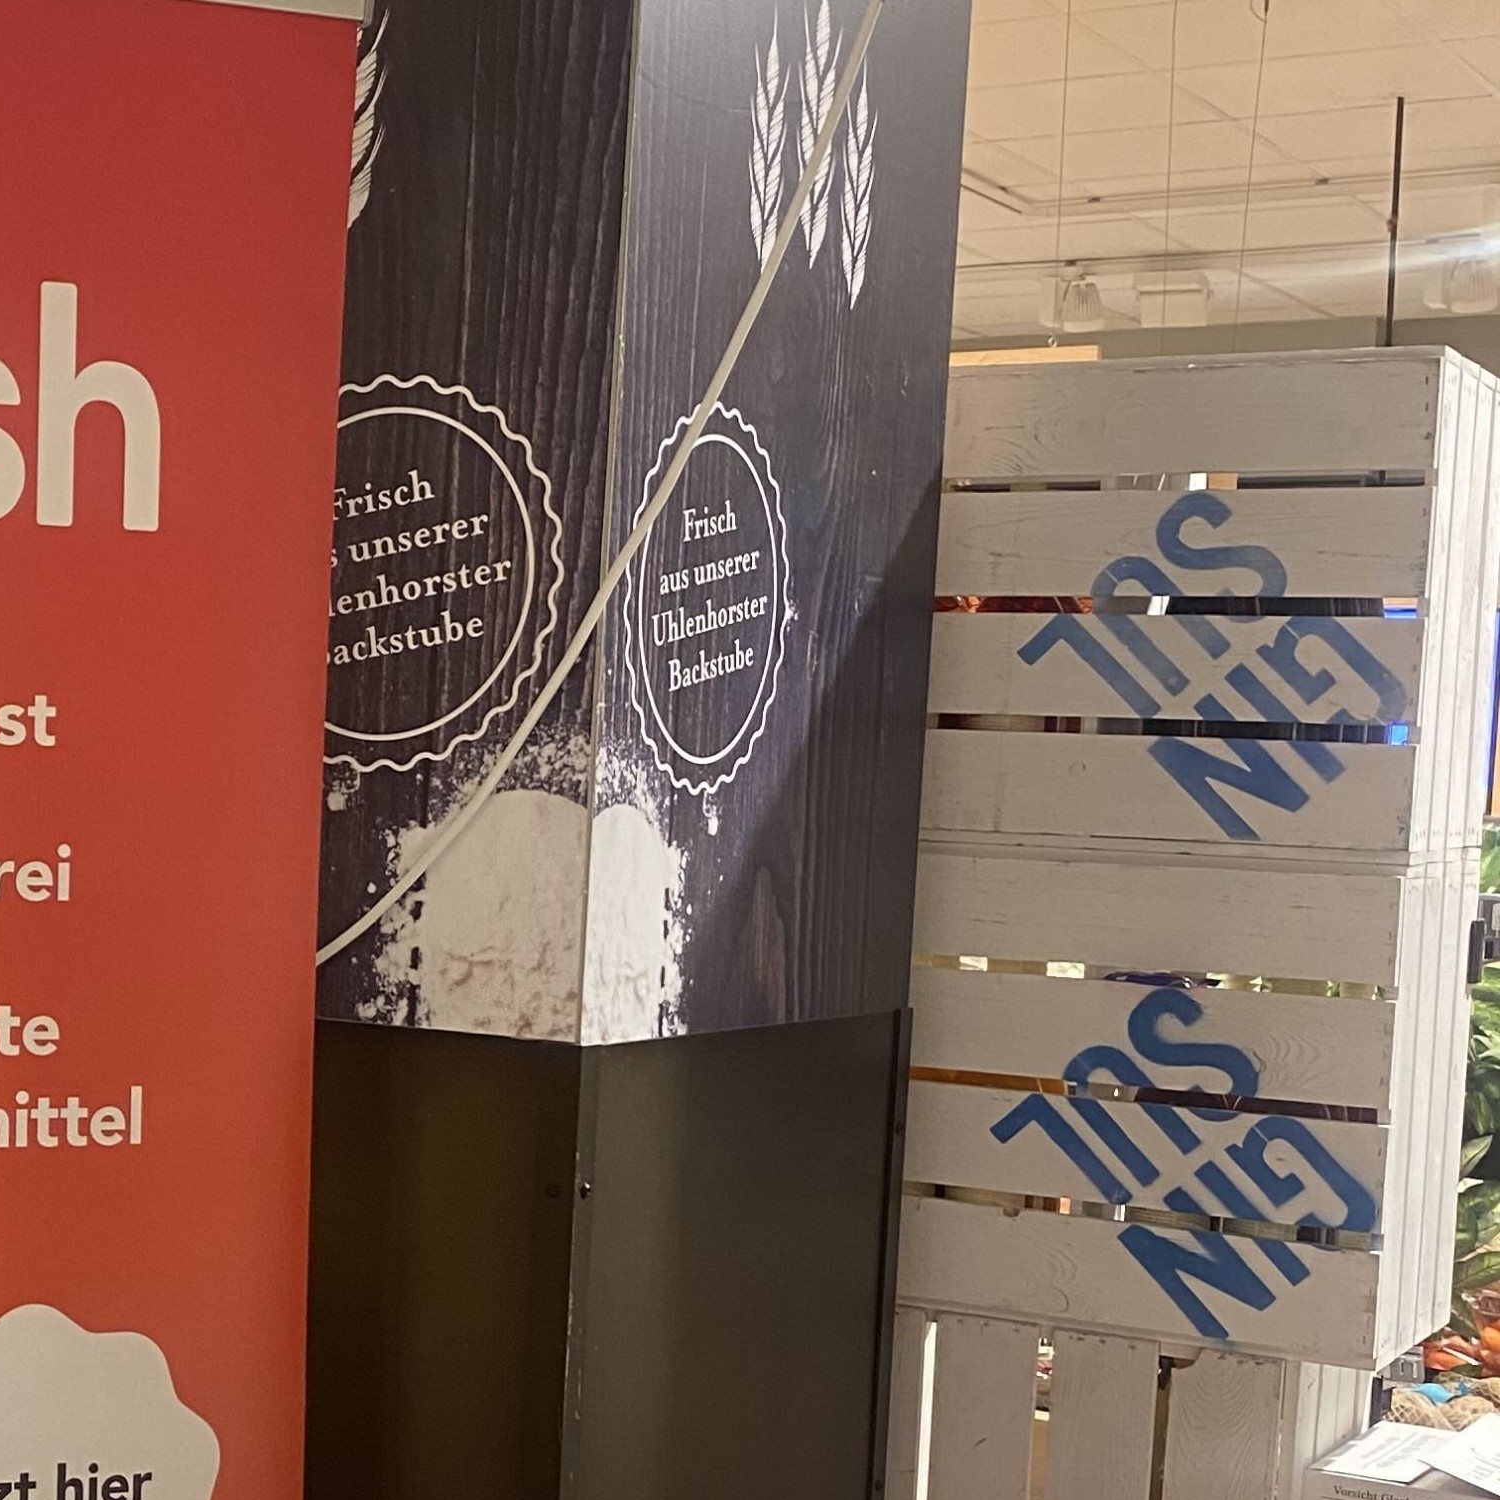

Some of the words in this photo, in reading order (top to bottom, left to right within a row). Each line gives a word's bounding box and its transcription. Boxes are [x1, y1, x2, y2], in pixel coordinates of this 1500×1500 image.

[347, 510, 489, 564] unserer
[682, 499, 738, 543] Frisch
[659, 567, 690, 597] aus
[693, 546, 761, 589] unserer
[326, 608, 485, 667] ackstube
[651, 592, 768, 648] Uhlenhorster
[668, 638, 755, 693] Backstube
